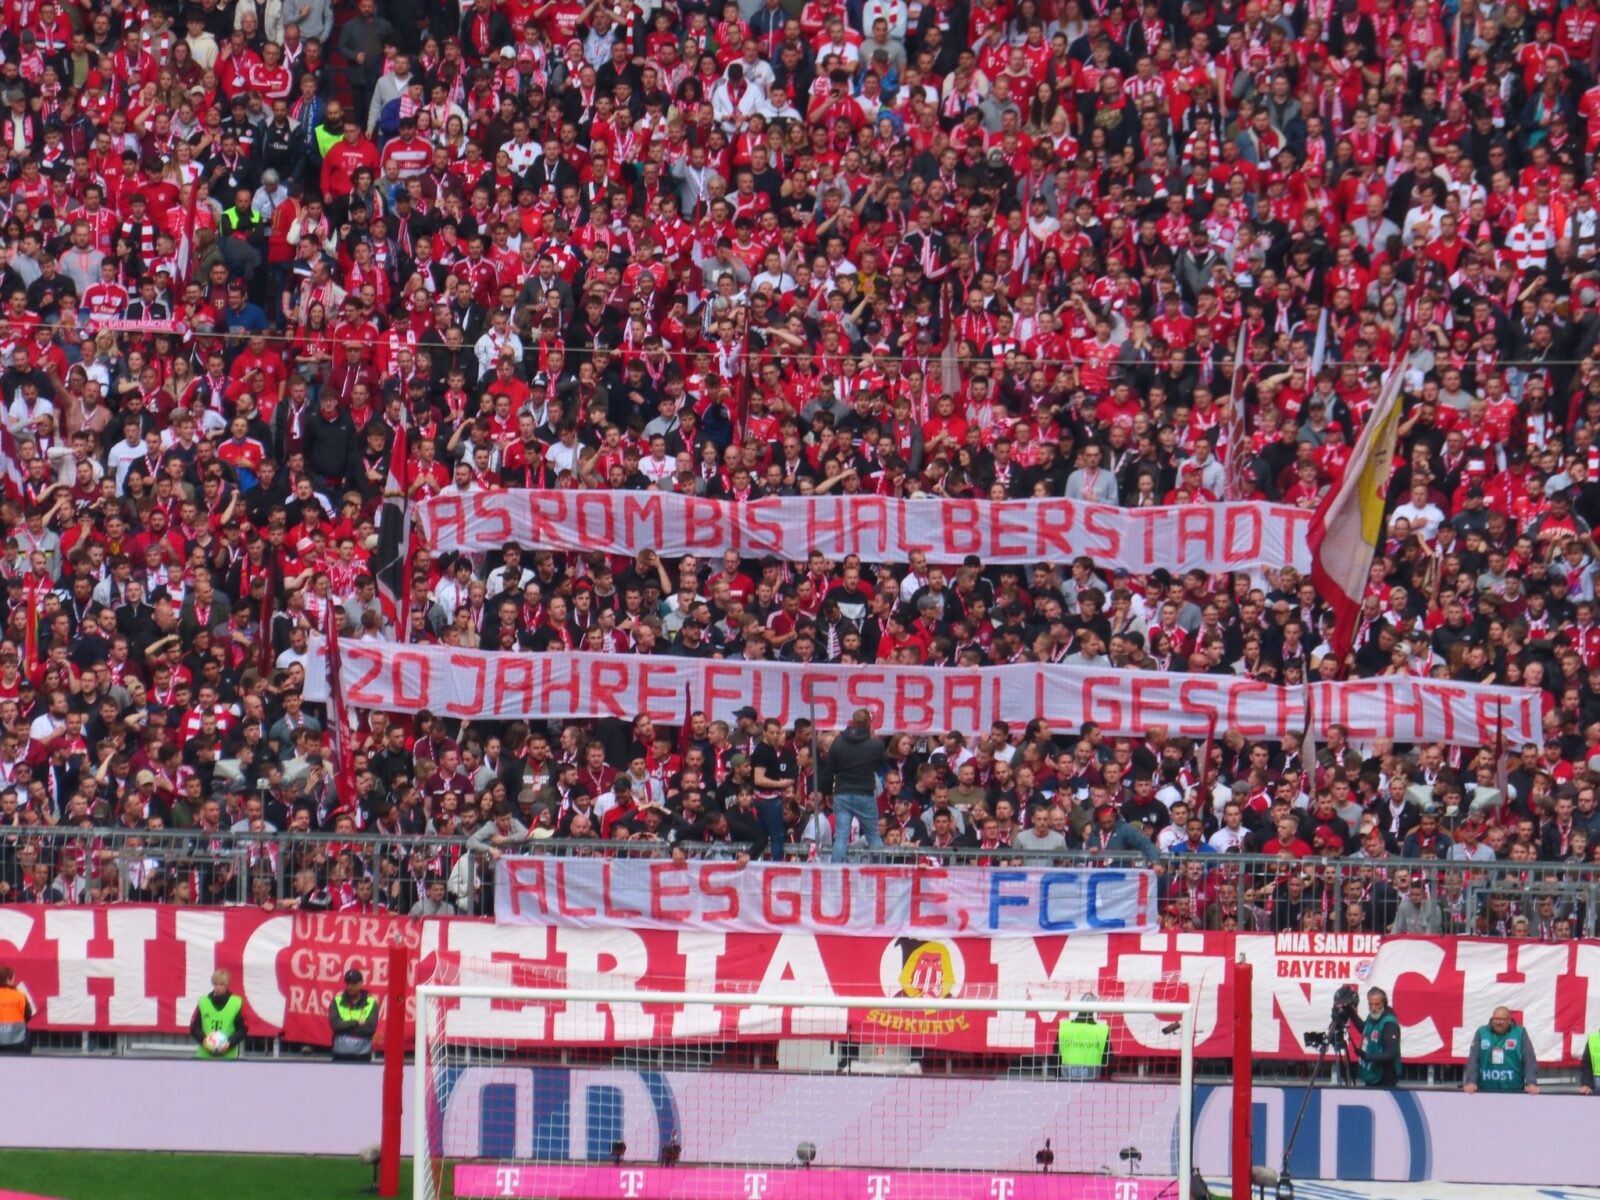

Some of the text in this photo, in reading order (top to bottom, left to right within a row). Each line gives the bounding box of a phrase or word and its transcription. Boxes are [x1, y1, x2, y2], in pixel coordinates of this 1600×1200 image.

[428, 487, 1313, 565] AS ROM BIS HALBERSTADT
[446, 657, 680, 720] JAHRE
[507, 860, 1149, 930] ALLES GUTE, FCC!
[294, 912, 420, 949] ULTRAS
[1277, 933, 1381, 954] MIA SAN DIE
[1277, 960, 1351, 979] BAYERN
[1482, 1069, 1514, 1082] HOST
